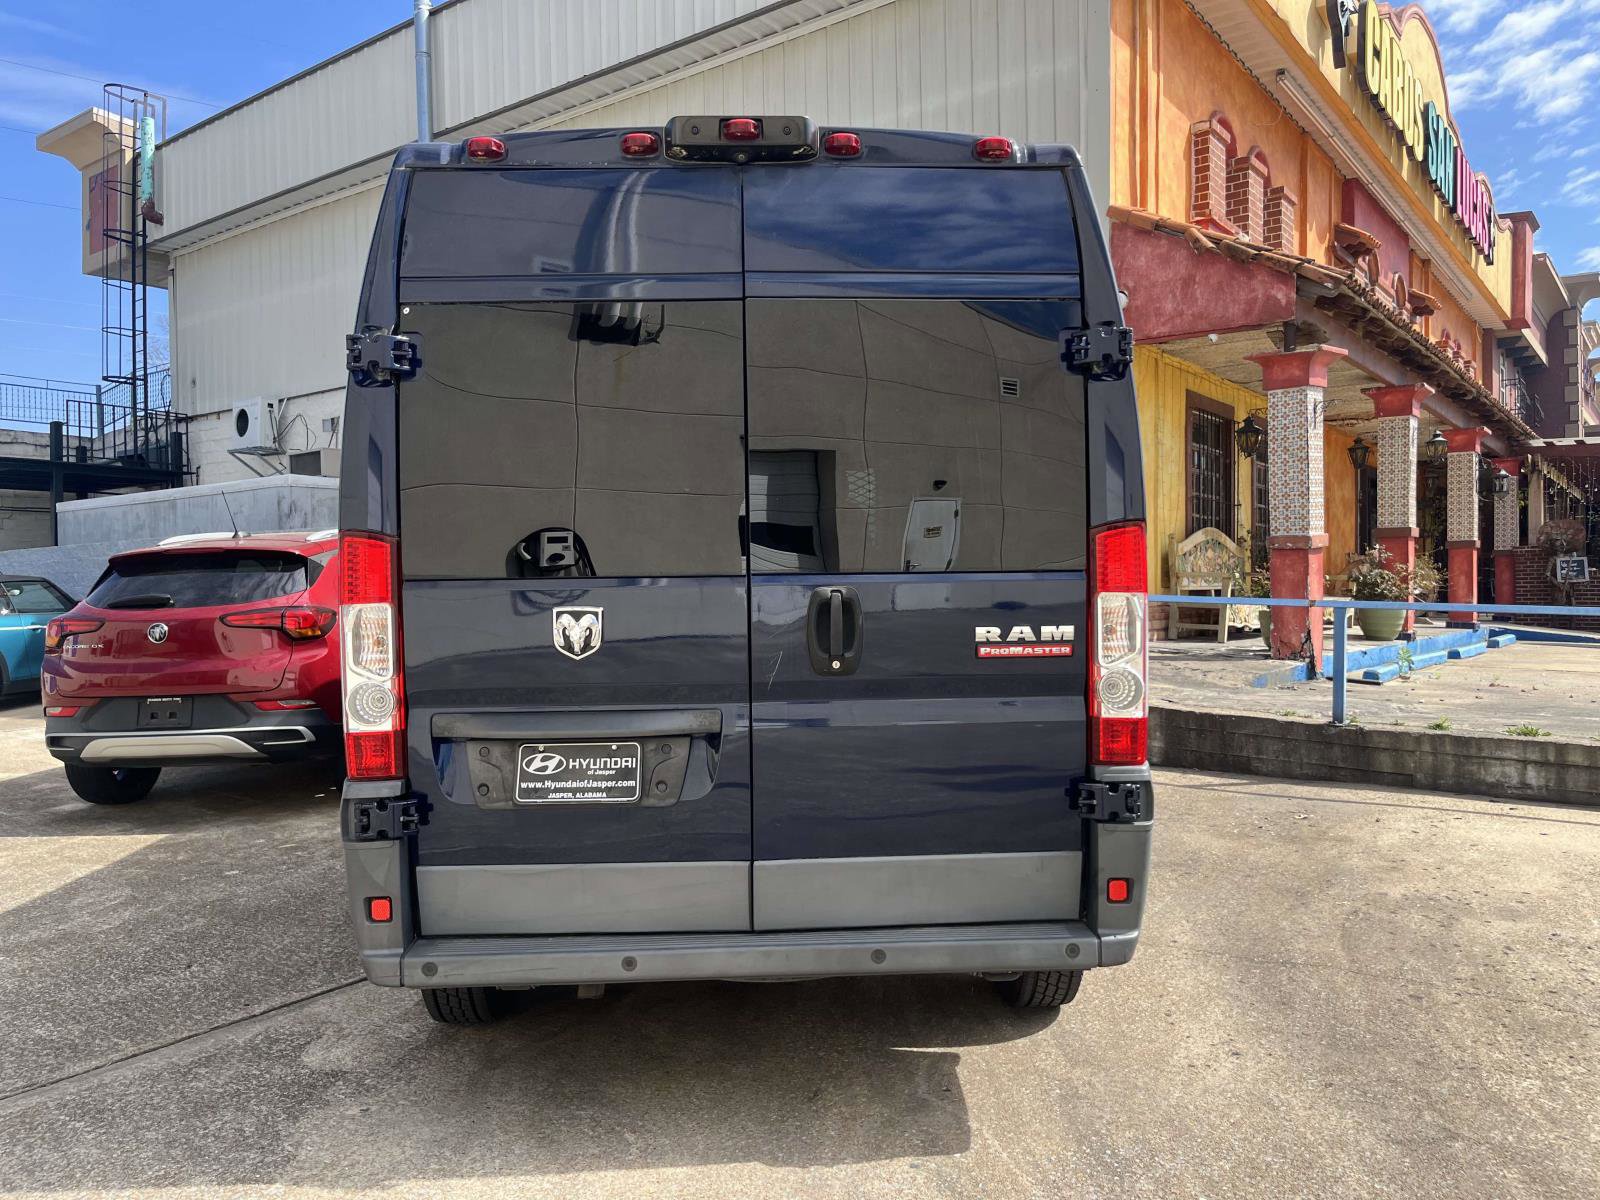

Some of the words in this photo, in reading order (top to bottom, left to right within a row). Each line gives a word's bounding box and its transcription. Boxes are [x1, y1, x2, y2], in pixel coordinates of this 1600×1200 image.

[1364, 0, 1424, 162] CABOS
[1429, 101, 1454, 208] SAN
[1457, 147, 1490, 255] LUCAS
[975, 625, 1075, 642] RAM
[569, 757, 636, 769] HYUNDAI
[520, 779, 636, 789] www.HyundaiofJasper.com
